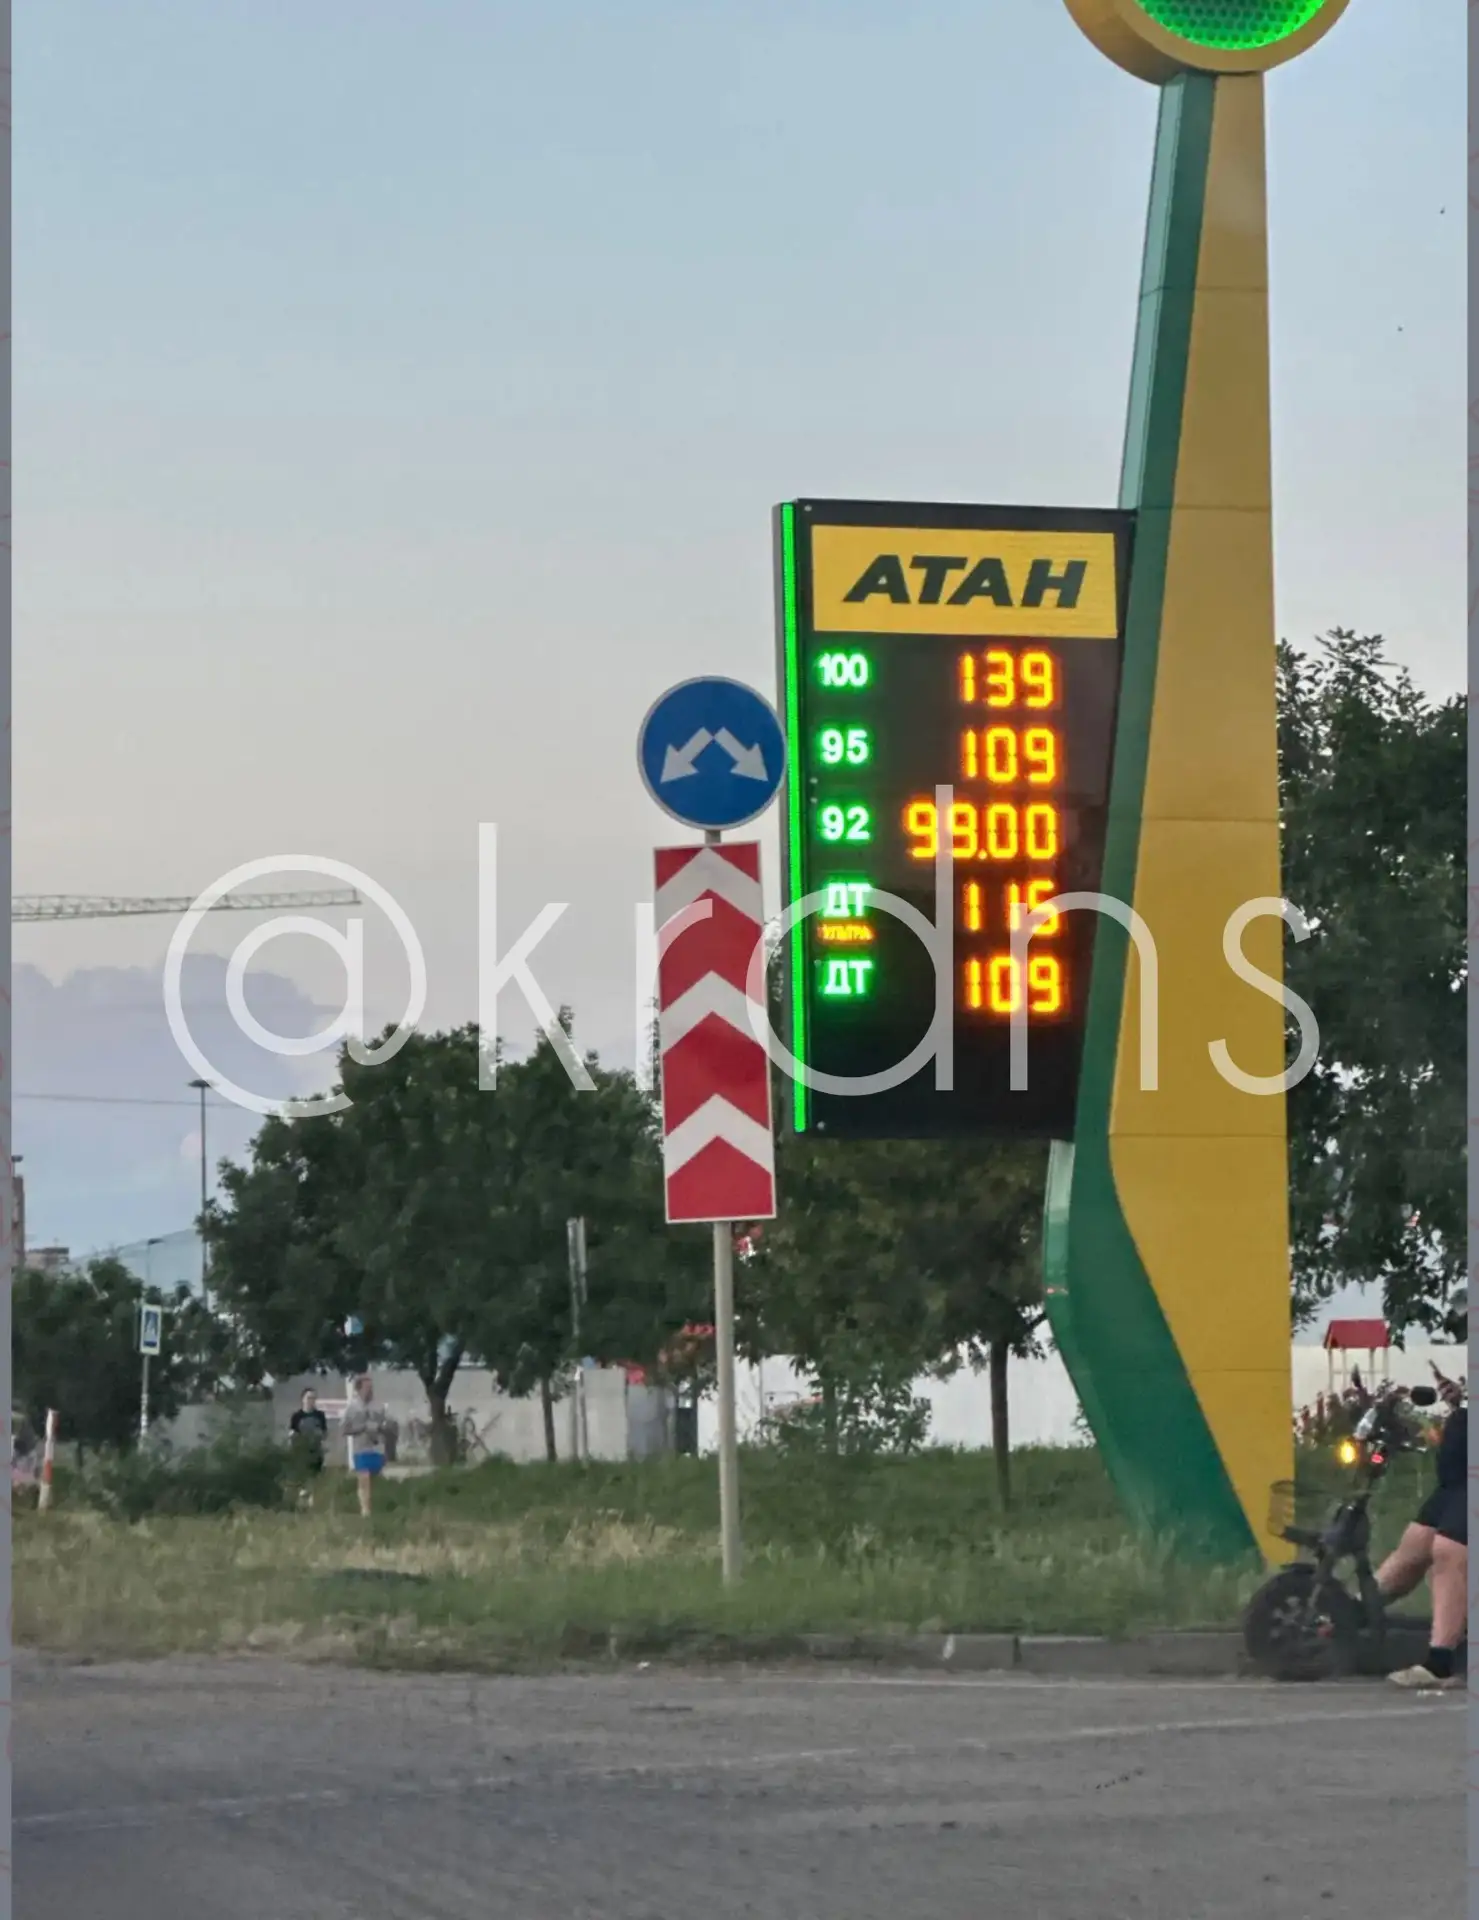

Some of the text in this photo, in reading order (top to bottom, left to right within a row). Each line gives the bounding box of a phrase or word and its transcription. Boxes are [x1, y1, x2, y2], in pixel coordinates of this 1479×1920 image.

[841, 554, 1088, 609] АТАН
[817, 650, 1056, 708] 100 139
[820, 727, 1057, 784] 95 109
[820, 802, 1058, 860] 92 99.00
[822, 880, 1060, 937] ДТ 115
[822, 956, 1062, 1014] ДТ 109
